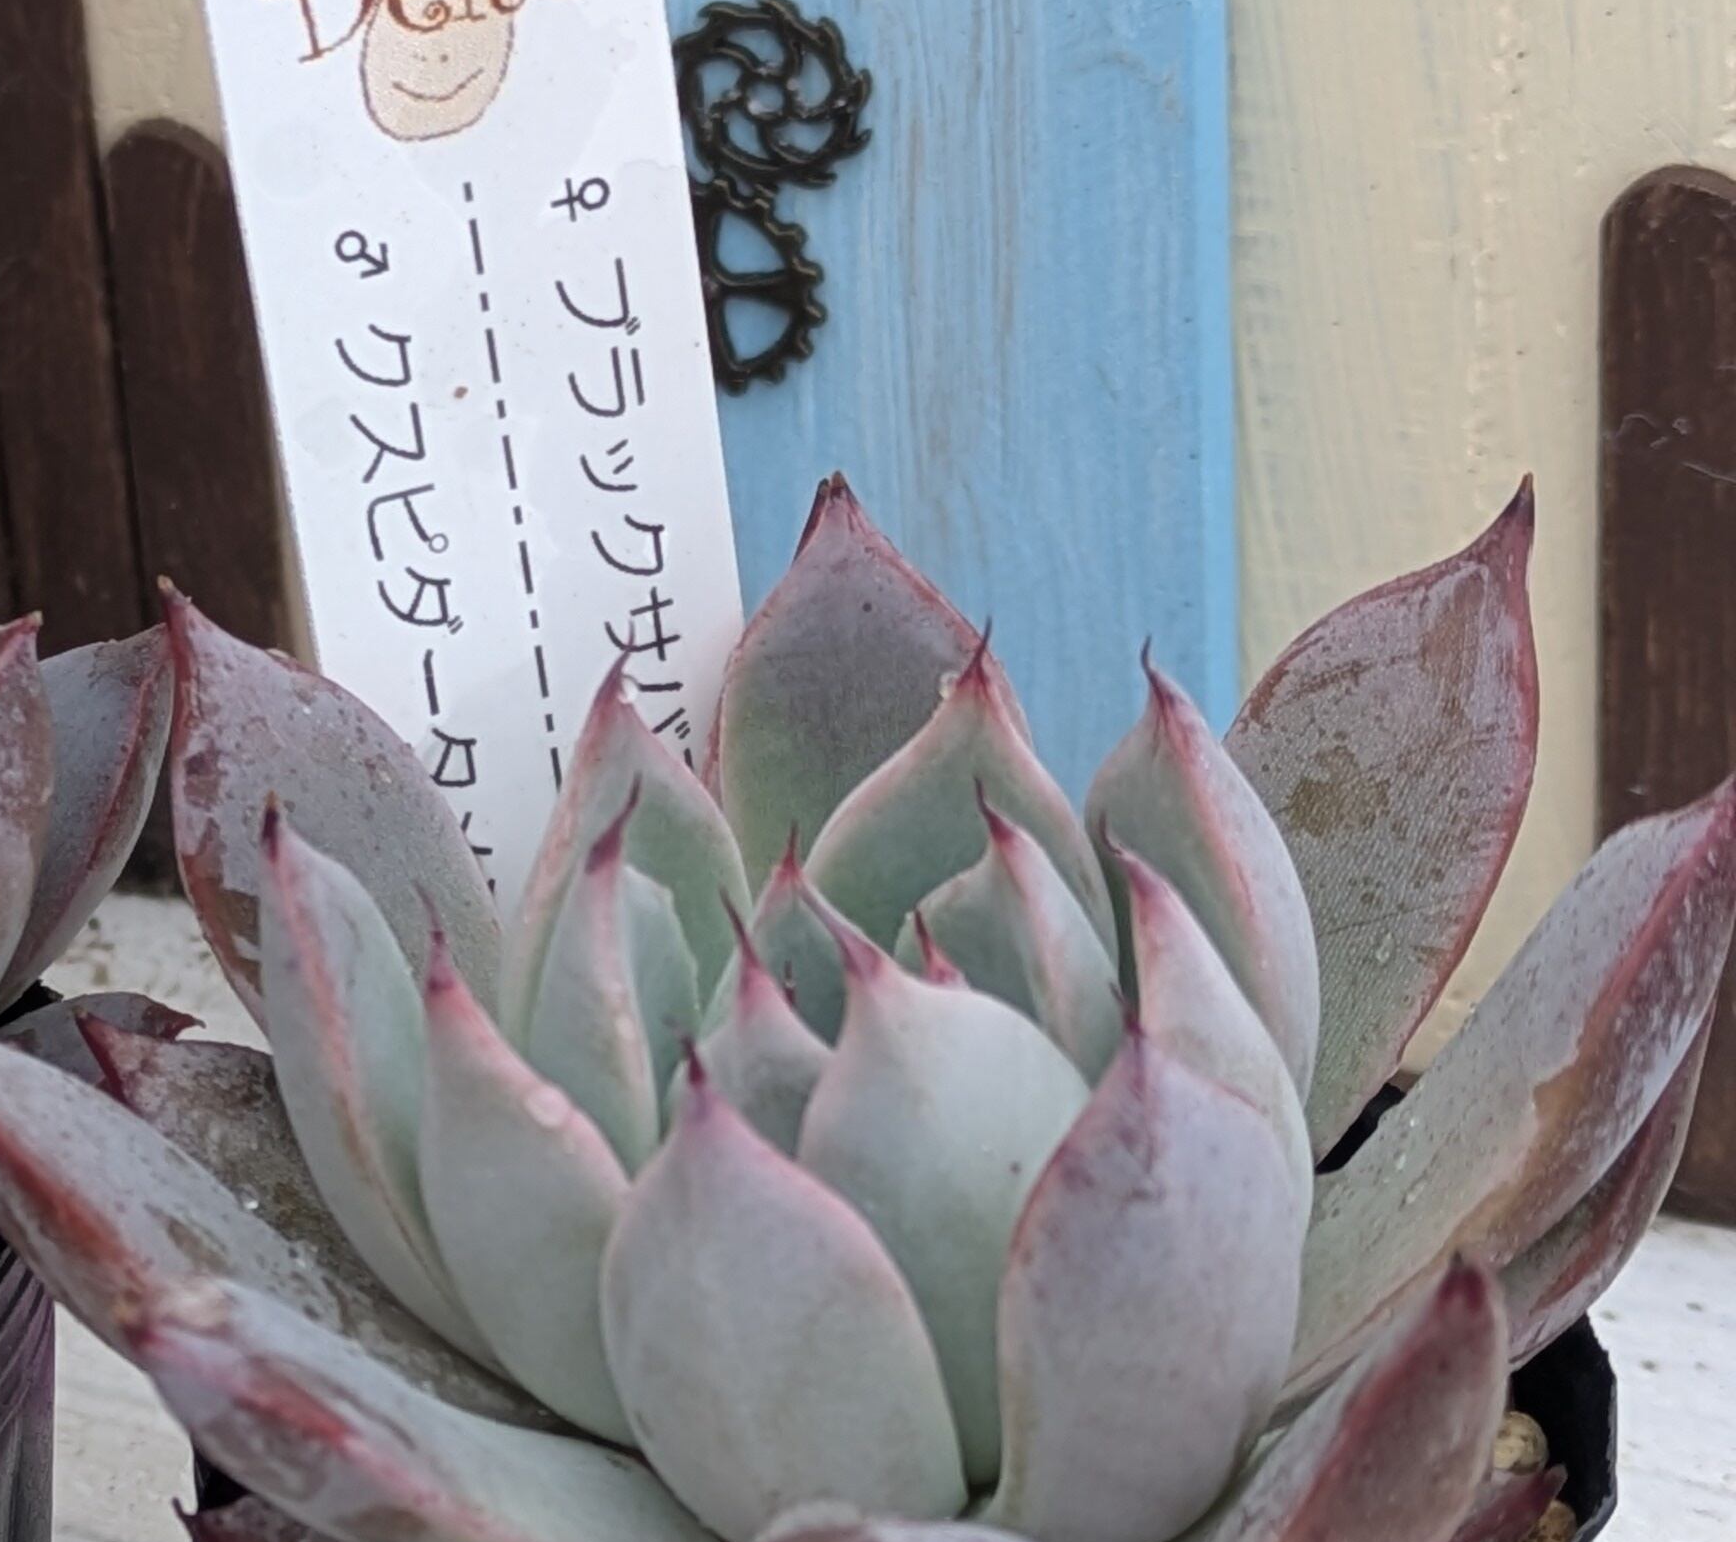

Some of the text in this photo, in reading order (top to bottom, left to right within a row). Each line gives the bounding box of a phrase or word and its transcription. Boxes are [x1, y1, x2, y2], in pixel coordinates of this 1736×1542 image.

[555, 256, 695, 770] ブラックサバ
